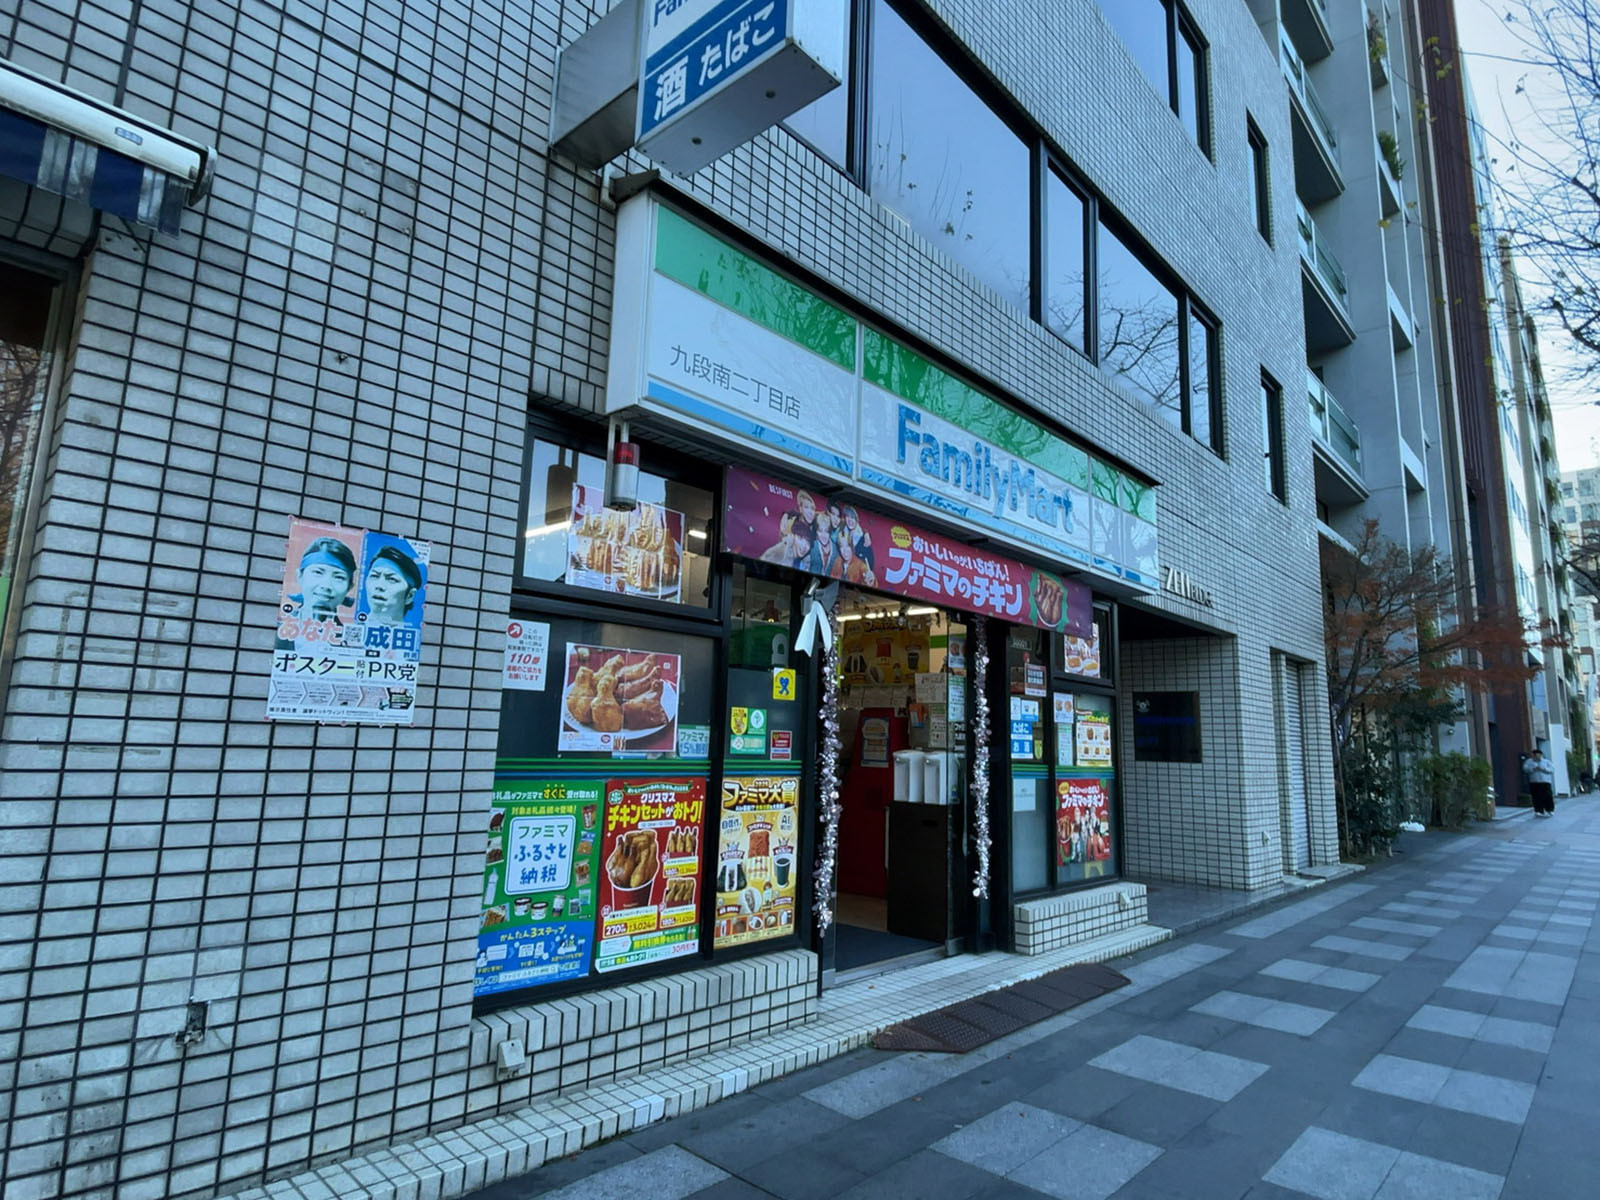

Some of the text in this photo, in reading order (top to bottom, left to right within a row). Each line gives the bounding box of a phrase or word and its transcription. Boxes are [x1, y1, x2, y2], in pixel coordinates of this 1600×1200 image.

[653, 2, 775, 121] 酒 たばこ
[670, 344, 801, 420] 九段南二丁目店
[896, 402, 1074, 534] FamilyMart
[885, 547, 1023, 617] ファミマのチキン
[278, 616, 343, 644] あなた
[365, 626, 416, 650] 成田
[640, 792, 676, 804] クリスマス
[723, 780, 796, 808] ファミマ大賞
[518, 824, 569, 840] ファミマ
[514, 843, 567, 862] ふるさと
[520, 864, 557, 885] 納税
